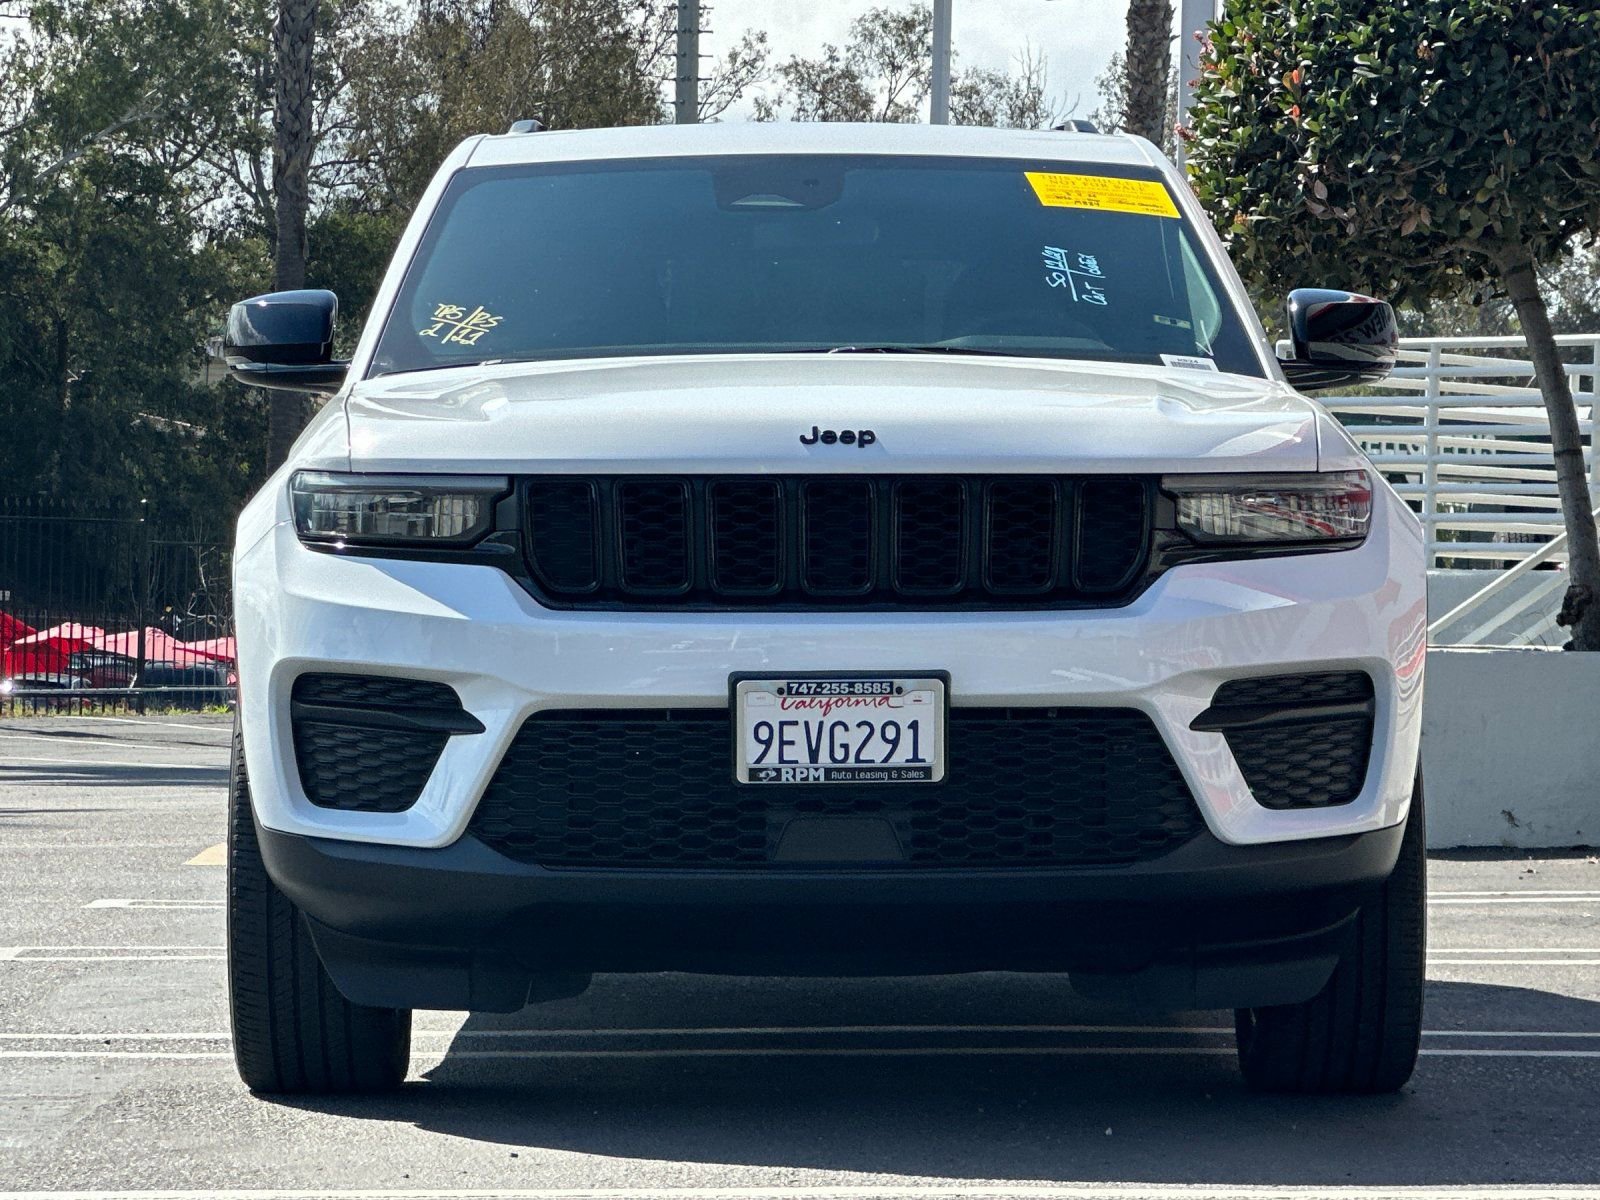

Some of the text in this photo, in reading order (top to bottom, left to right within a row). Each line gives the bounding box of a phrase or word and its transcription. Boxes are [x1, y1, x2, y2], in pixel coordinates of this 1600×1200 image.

[799, 426, 876, 448] Jeep
[789, 682, 892, 695] 747-255-8585
[780, 695, 904, 717] California
[753, 720, 926, 764] 9EVG291
[781, 767, 925, 782] RPM Auto Leasing & Sales
